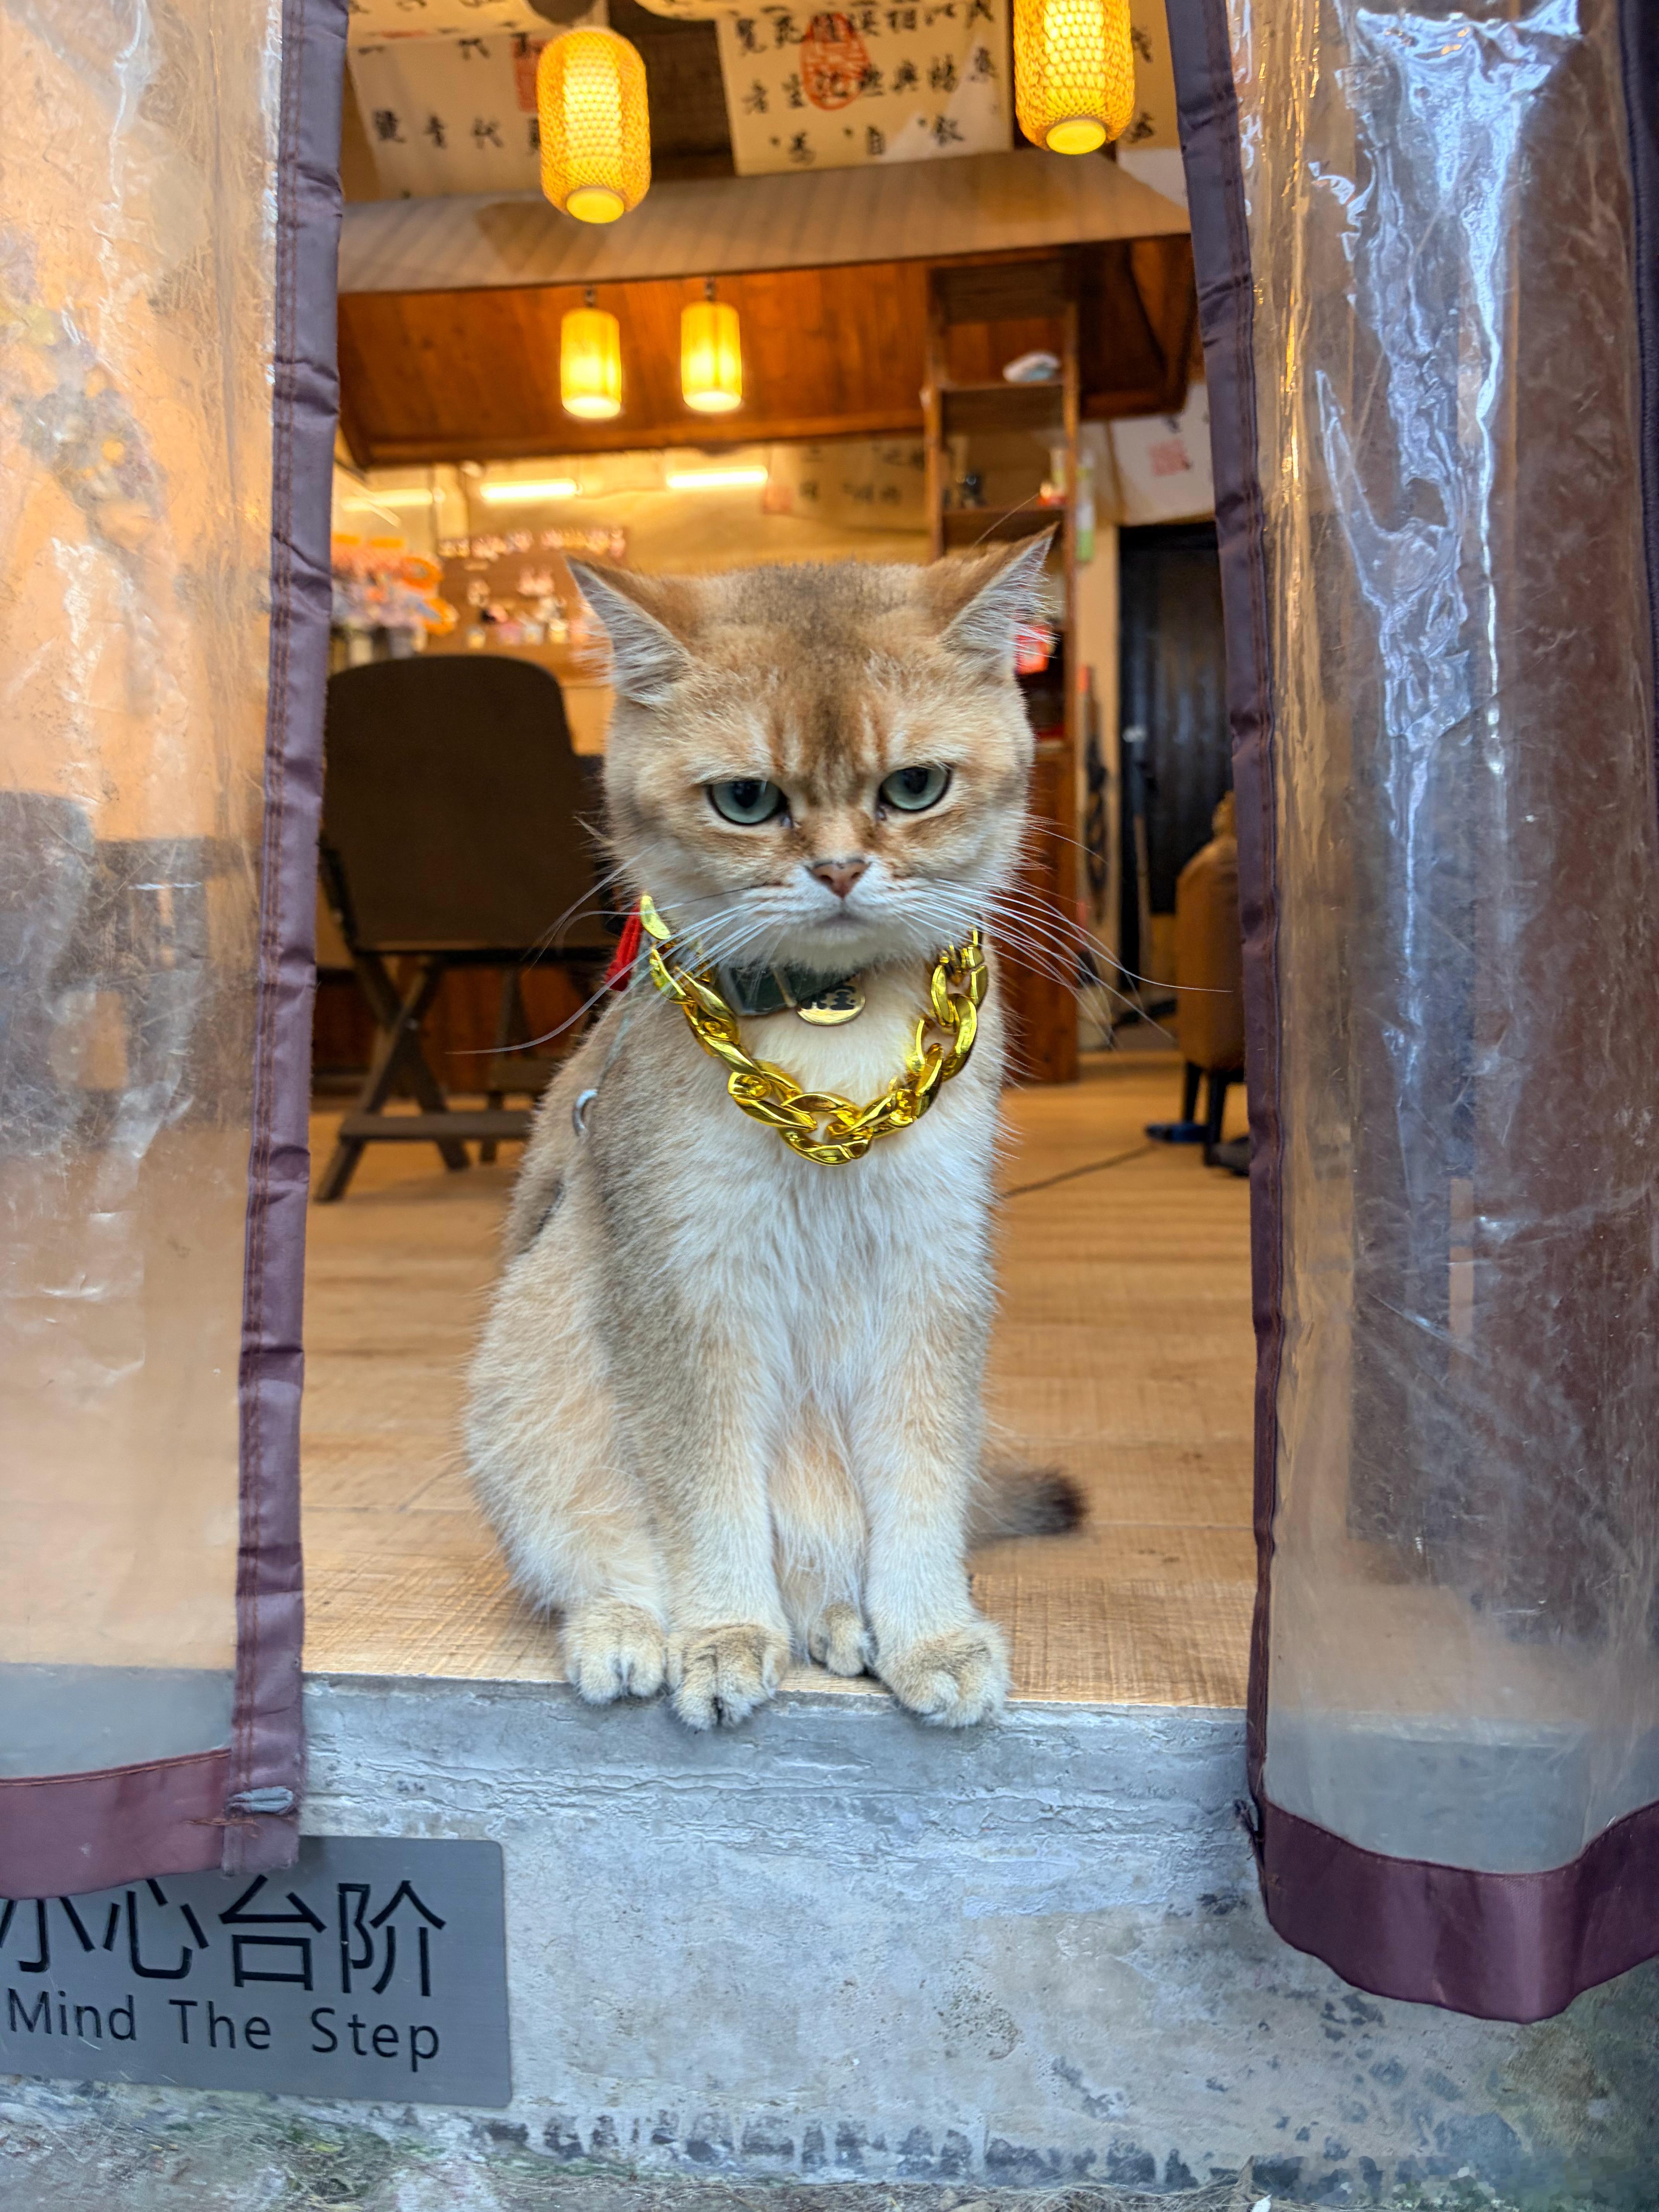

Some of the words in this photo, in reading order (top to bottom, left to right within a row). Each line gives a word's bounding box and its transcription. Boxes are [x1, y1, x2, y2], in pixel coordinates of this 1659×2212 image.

[8, 1988, 136, 2040] Mind
[169, 1999, 271, 2050] The
[310, 2008, 439, 2073] Step
